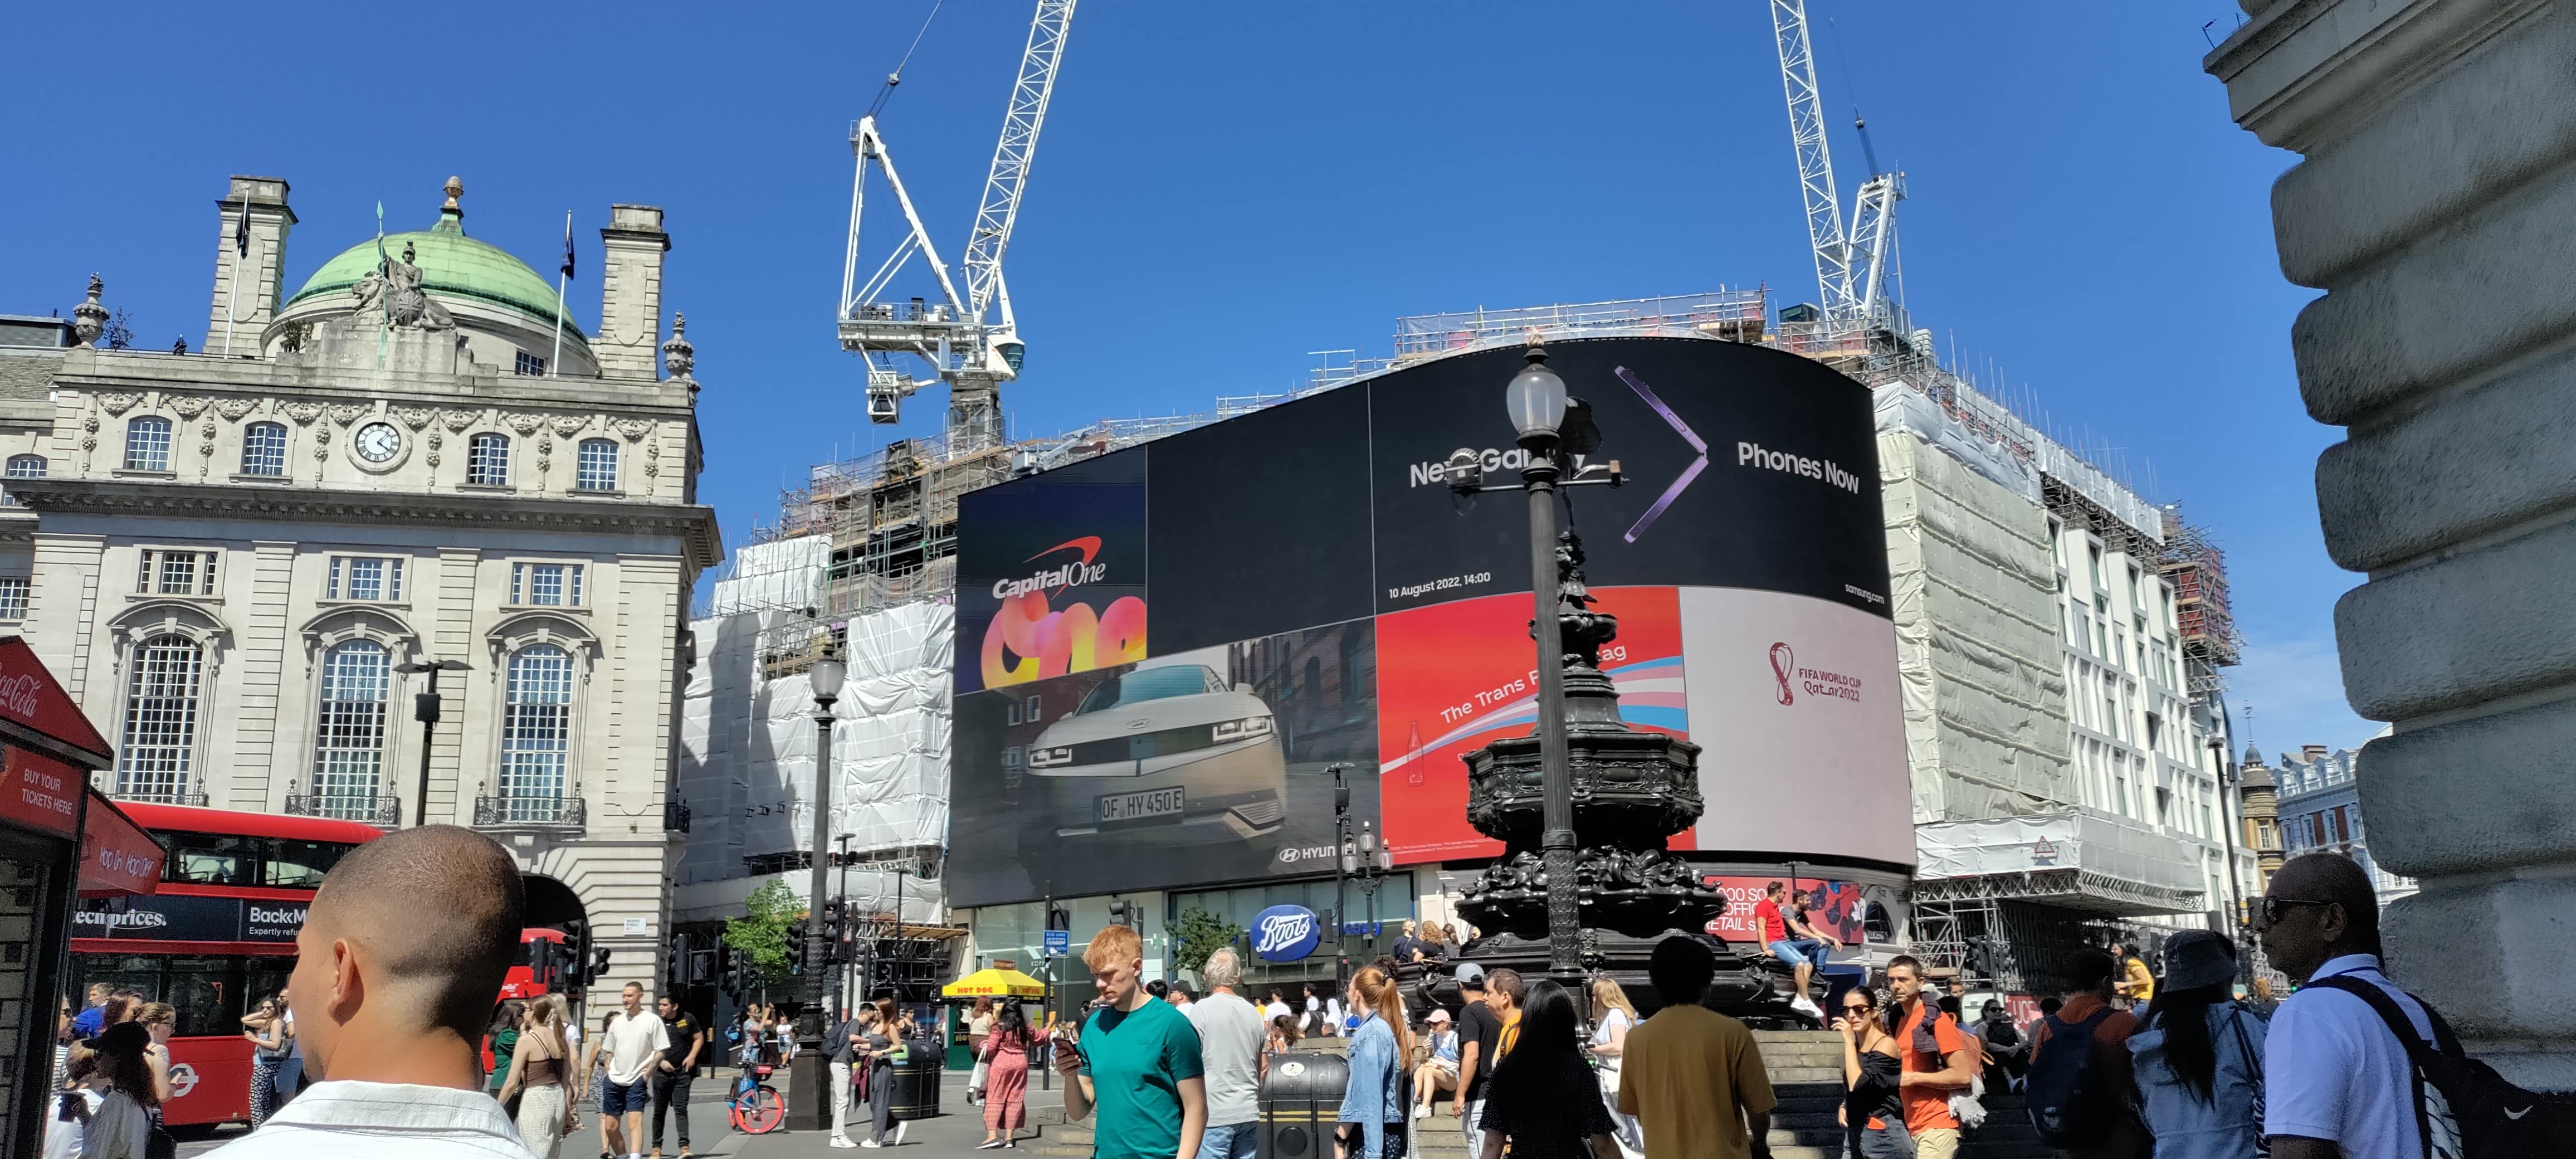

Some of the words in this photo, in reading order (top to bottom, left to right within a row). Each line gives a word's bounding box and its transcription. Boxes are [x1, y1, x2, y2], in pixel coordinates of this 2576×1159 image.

[1738, 442, 1822, 479] Phones
[1824, 460, 1858, 494] Now
[1389, 588, 1399, 598] 10
[1401, 581, 1435, 597] August
[1436, 576, 1462, 590] 2022,
[1464, 572, 1491, 585] 14:00
[1845, 584, 1885, 605] samsung.com
[1799, 668, 1819, 680] FIFA
[1819, 671, 1848, 685] WORLD
[1849, 677, 1861, 688] CUP
[1440, 702, 1472, 723] The
[1475, 679, 1525, 707] Trans
[25, 768, 40, 785] BUY
[41, 773, 61, 792] YOUR
[22, 788, 52, 809] TICKETS
[53, 798, 72, 815] HERE
[1102, 798, 1118, 818] OF
[1128, 795, 1144, 816] HY
[109, 909, 167, 928] prices.
[249, 927, 281, 936] Expertly
[1256, 913, 1310, 952] Boots
